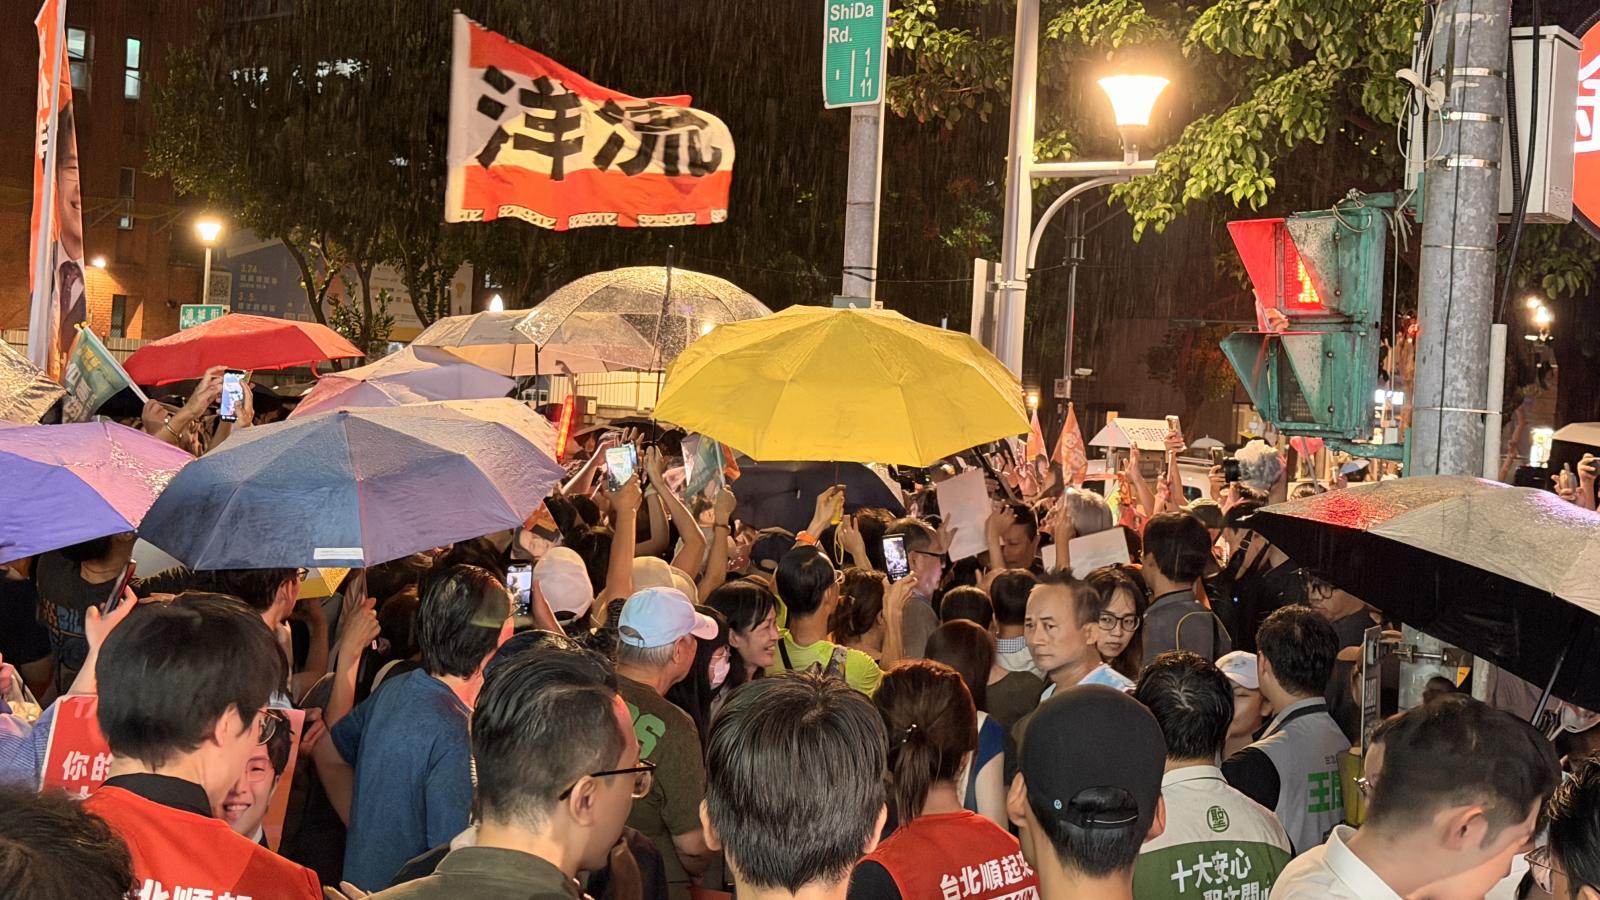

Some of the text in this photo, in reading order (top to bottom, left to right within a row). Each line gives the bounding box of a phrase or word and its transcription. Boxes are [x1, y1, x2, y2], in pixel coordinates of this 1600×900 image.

[830, 2, 874, 21] ShiDa
[829, 26, 853, 44] Rd.
[476, 64, 722, 181] 洋流
[1170, 847, 1252, 893] 十大安心
